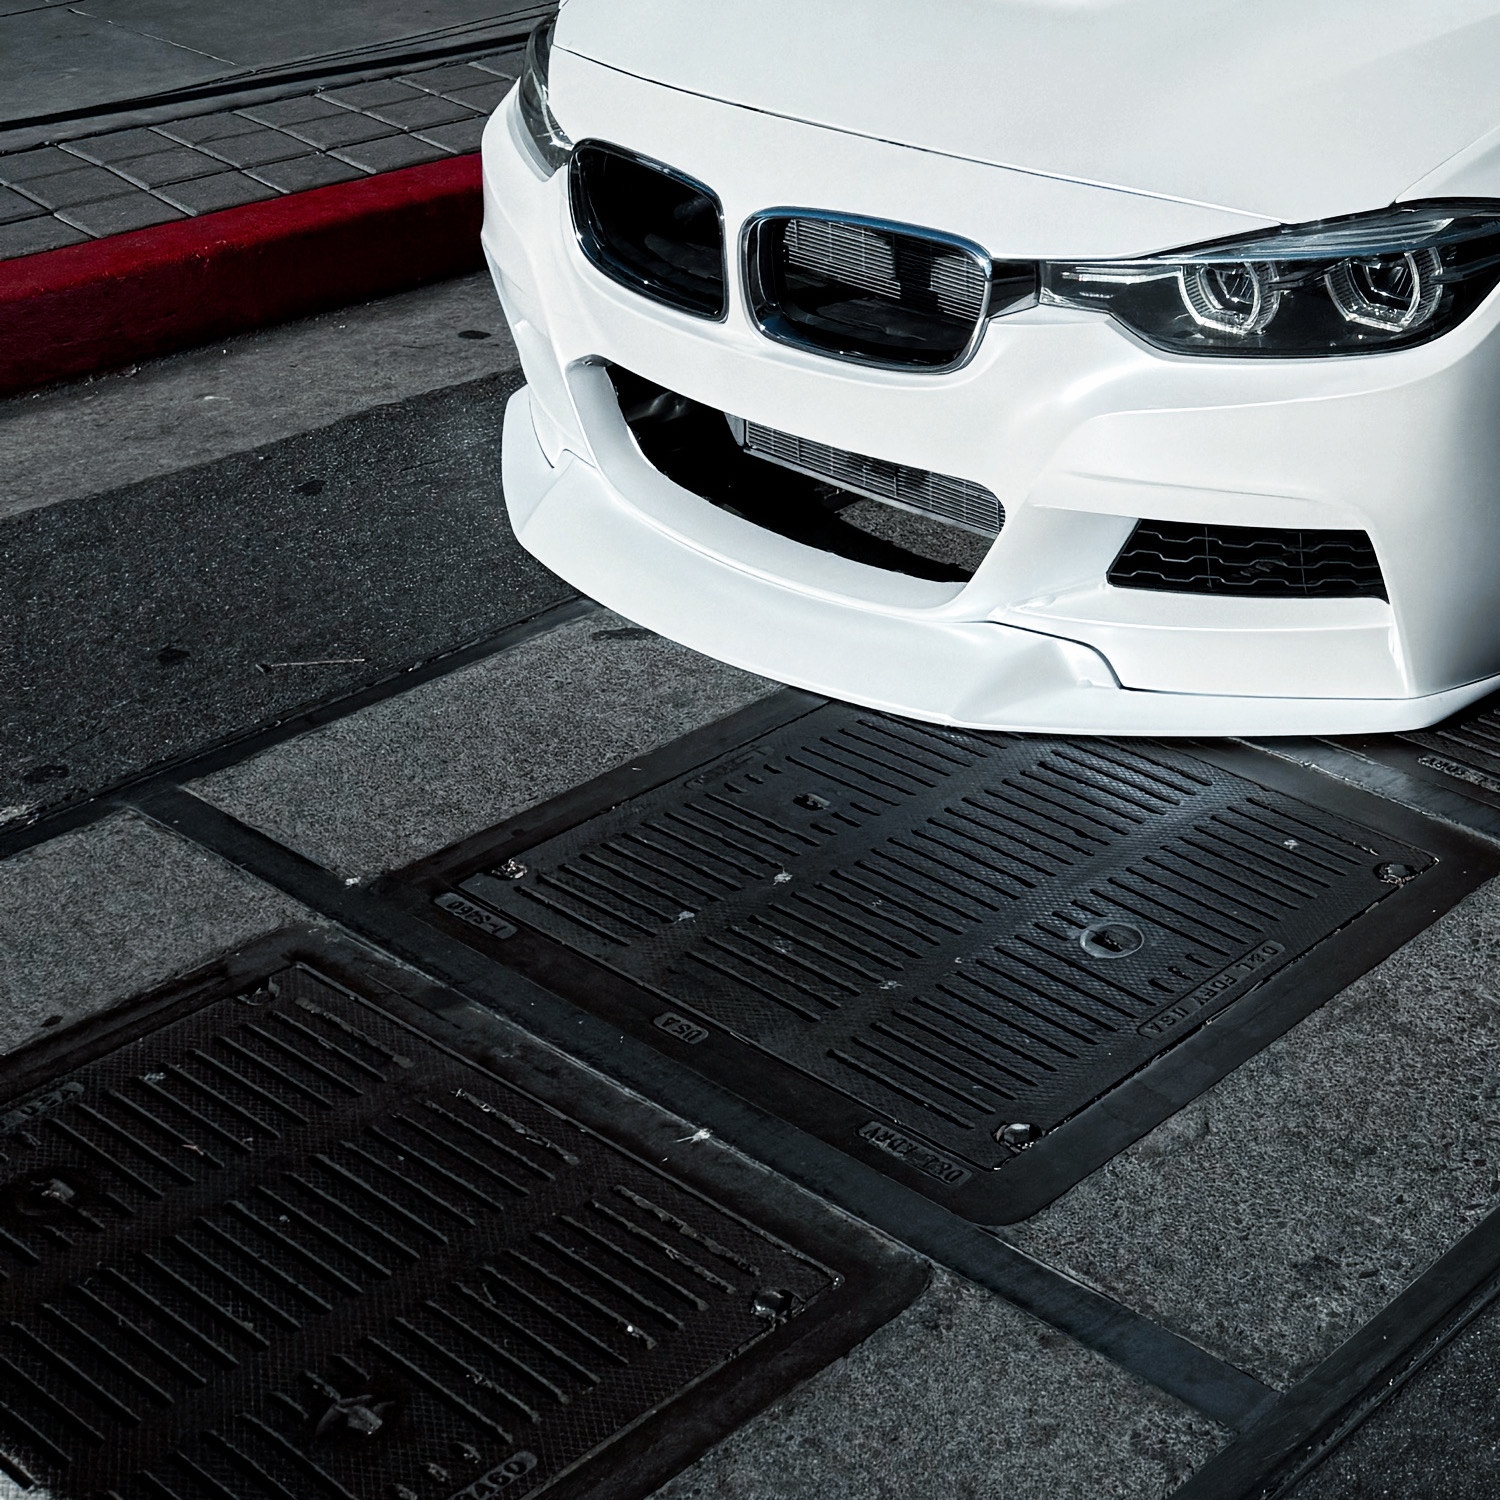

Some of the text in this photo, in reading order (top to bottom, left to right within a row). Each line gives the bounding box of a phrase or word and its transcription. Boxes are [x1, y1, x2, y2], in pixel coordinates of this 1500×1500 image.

[1235, 945, 1279, 971] D&L
[661, 1016, 702, 1041] USA
[1149, 1006, 1190, 1033] USA
